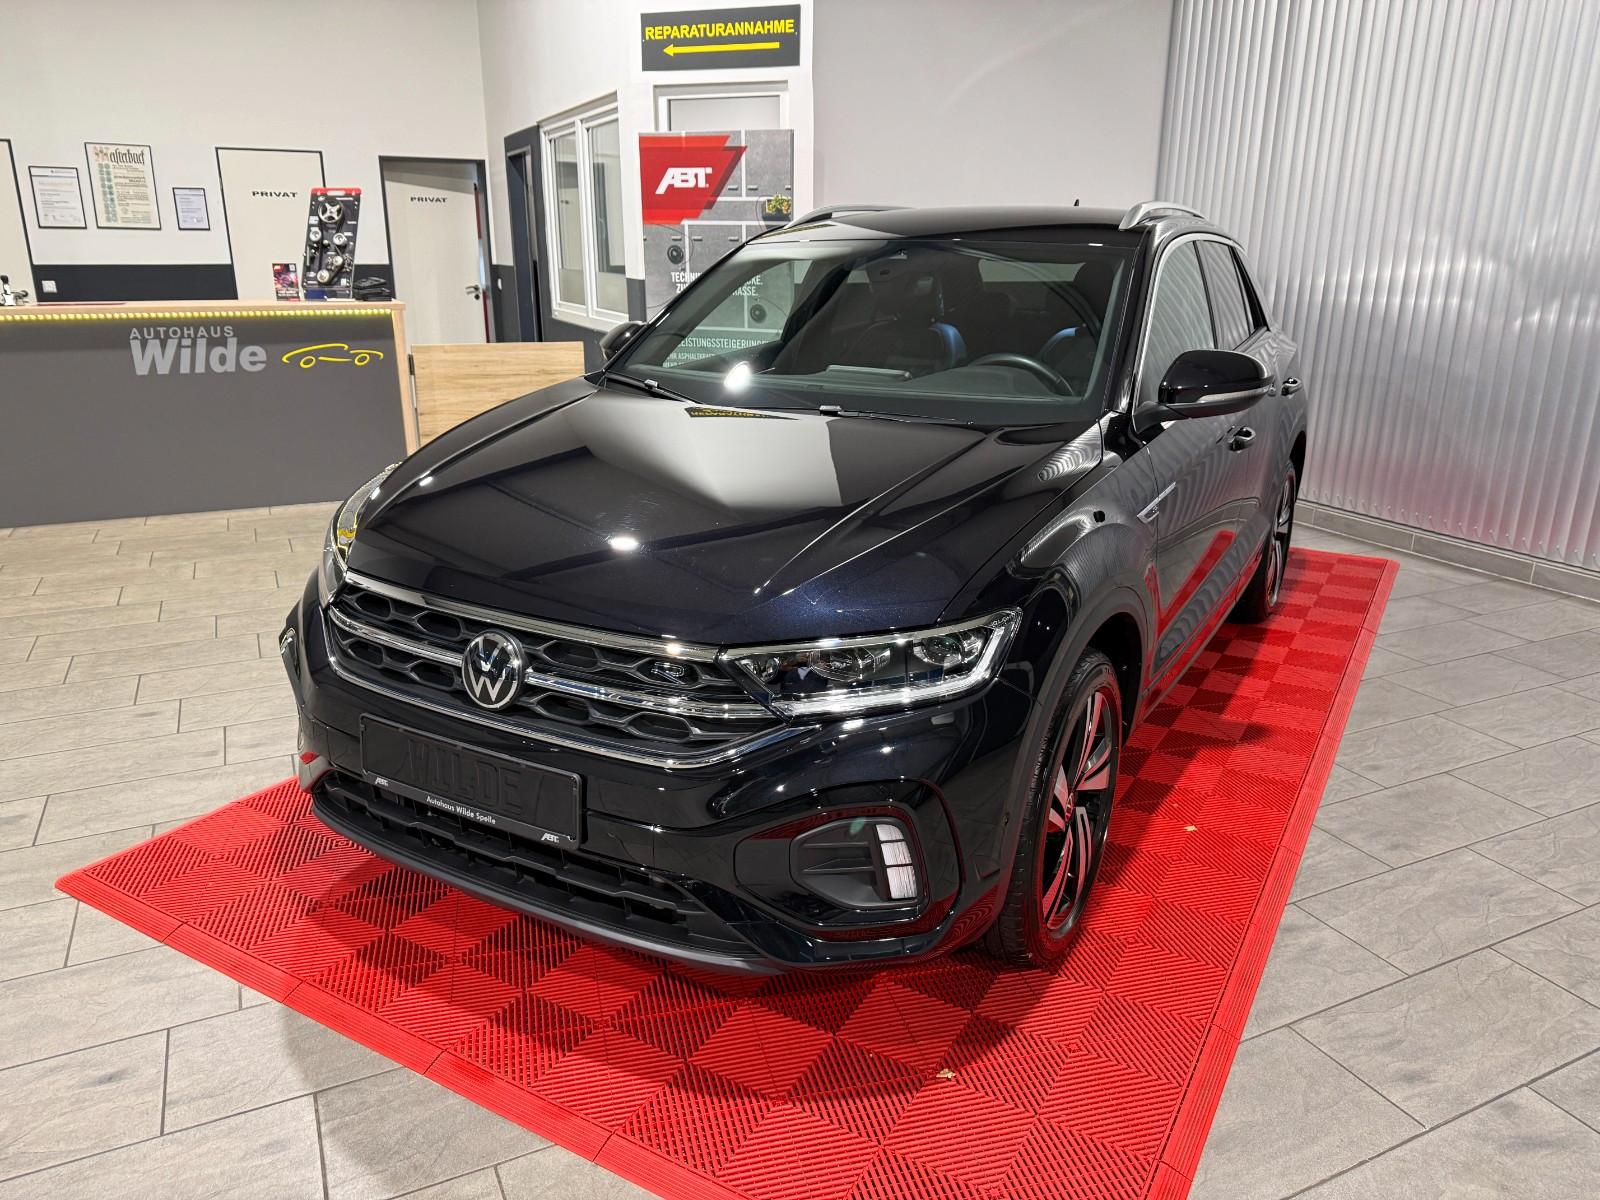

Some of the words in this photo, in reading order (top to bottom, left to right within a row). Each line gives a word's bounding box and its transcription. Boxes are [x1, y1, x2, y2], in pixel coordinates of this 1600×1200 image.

[644, 19, 795, 41] REPARATURANNAHME
[655, 167, 713, 195] ABT
[251, 190, 298, 198] PRIVAT
[129, 325, 234, 340] AUTOHAUS
[129, 337, 267, 376] Wilde
[374, 776, 389, 788] ABT
[426, 795, 455, 812] Autohaus
[456, 805, 475, 818] Wilde
[540, 832, 560, 843] ABT
